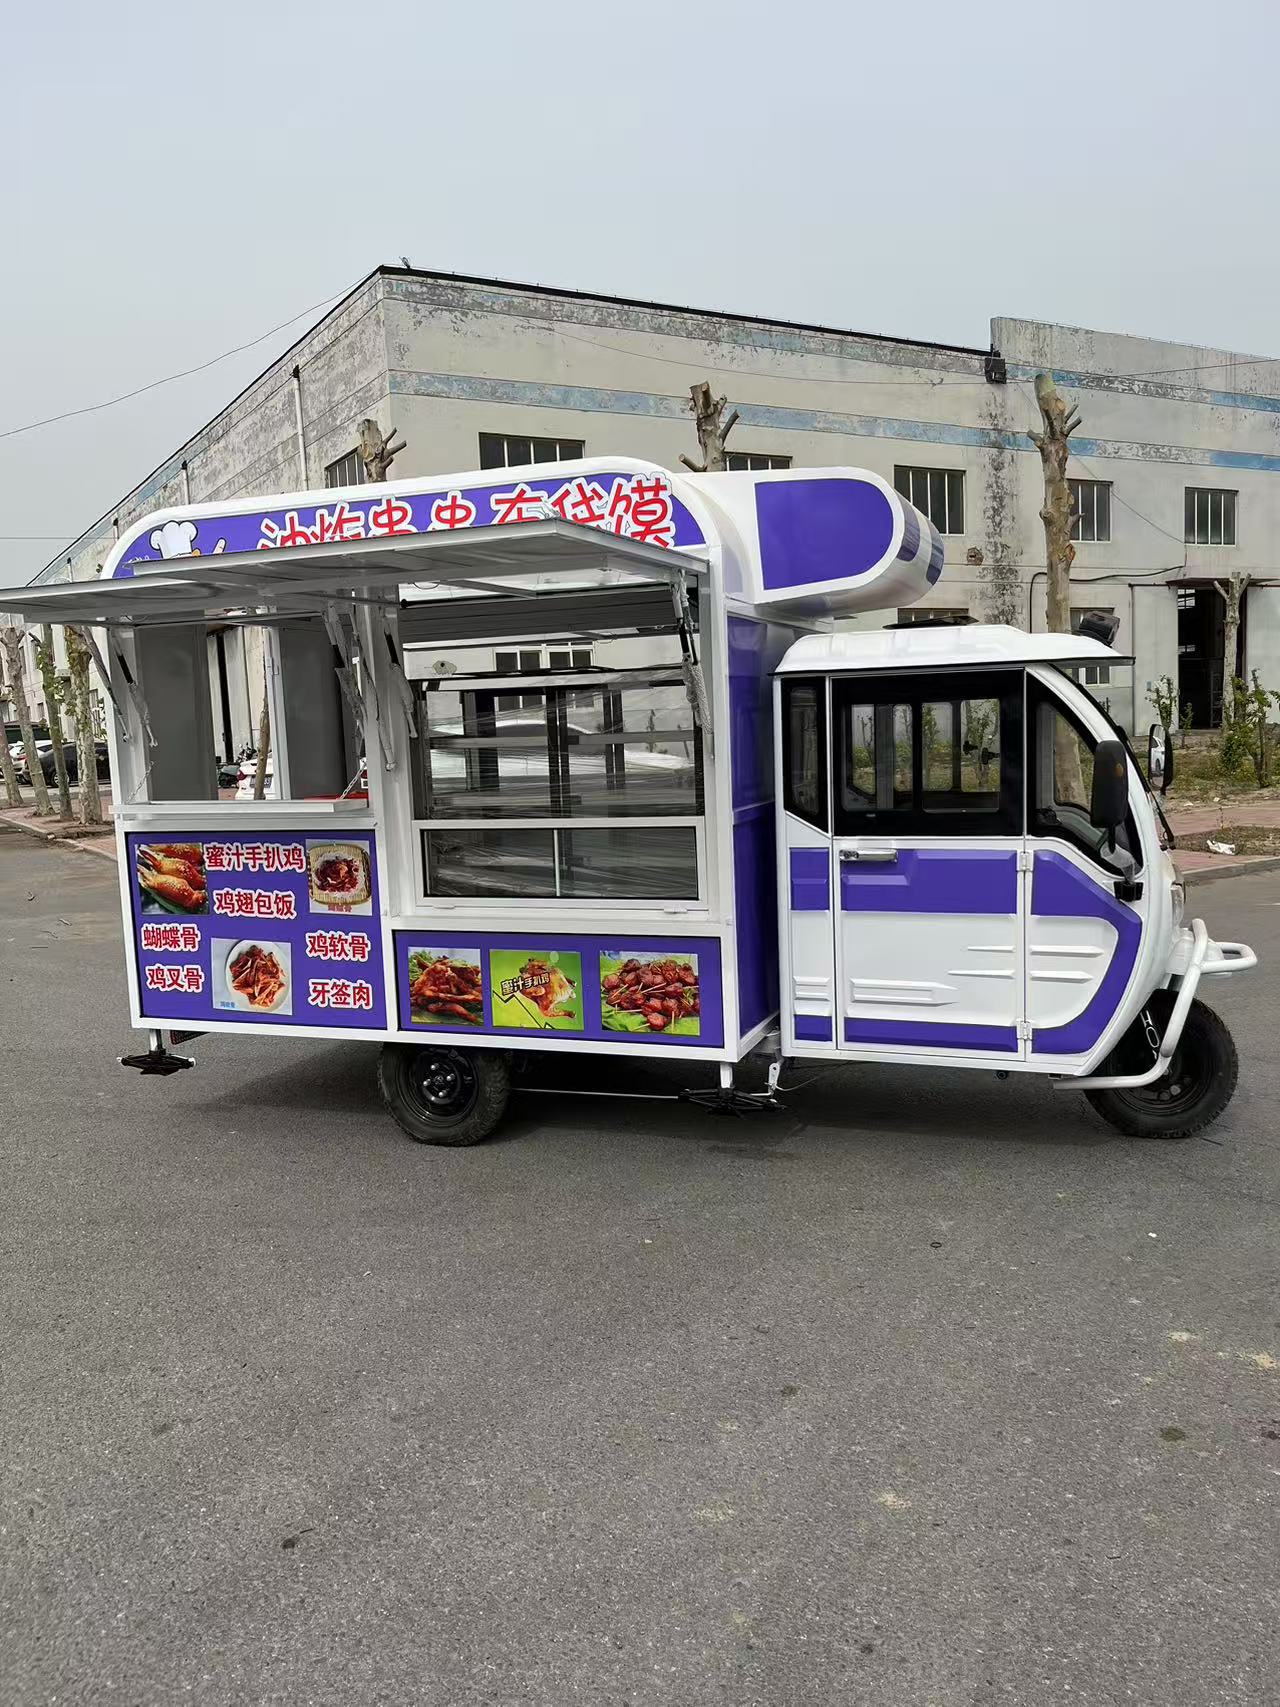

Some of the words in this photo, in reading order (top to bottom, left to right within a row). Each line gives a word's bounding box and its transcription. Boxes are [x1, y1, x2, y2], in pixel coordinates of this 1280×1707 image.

[204, 843, 306, 872] 蜜汁手扒鸡
[214, 889, 296, 919] 鸡翅包饭
[142, 924, 200, 951] 蝴蝶骨
[306, 931, 370, 961] 鸡软骨
[146, 964, 204, 992] 鸡叉骨
[308, 979, 372, 1009] 牙签肉
